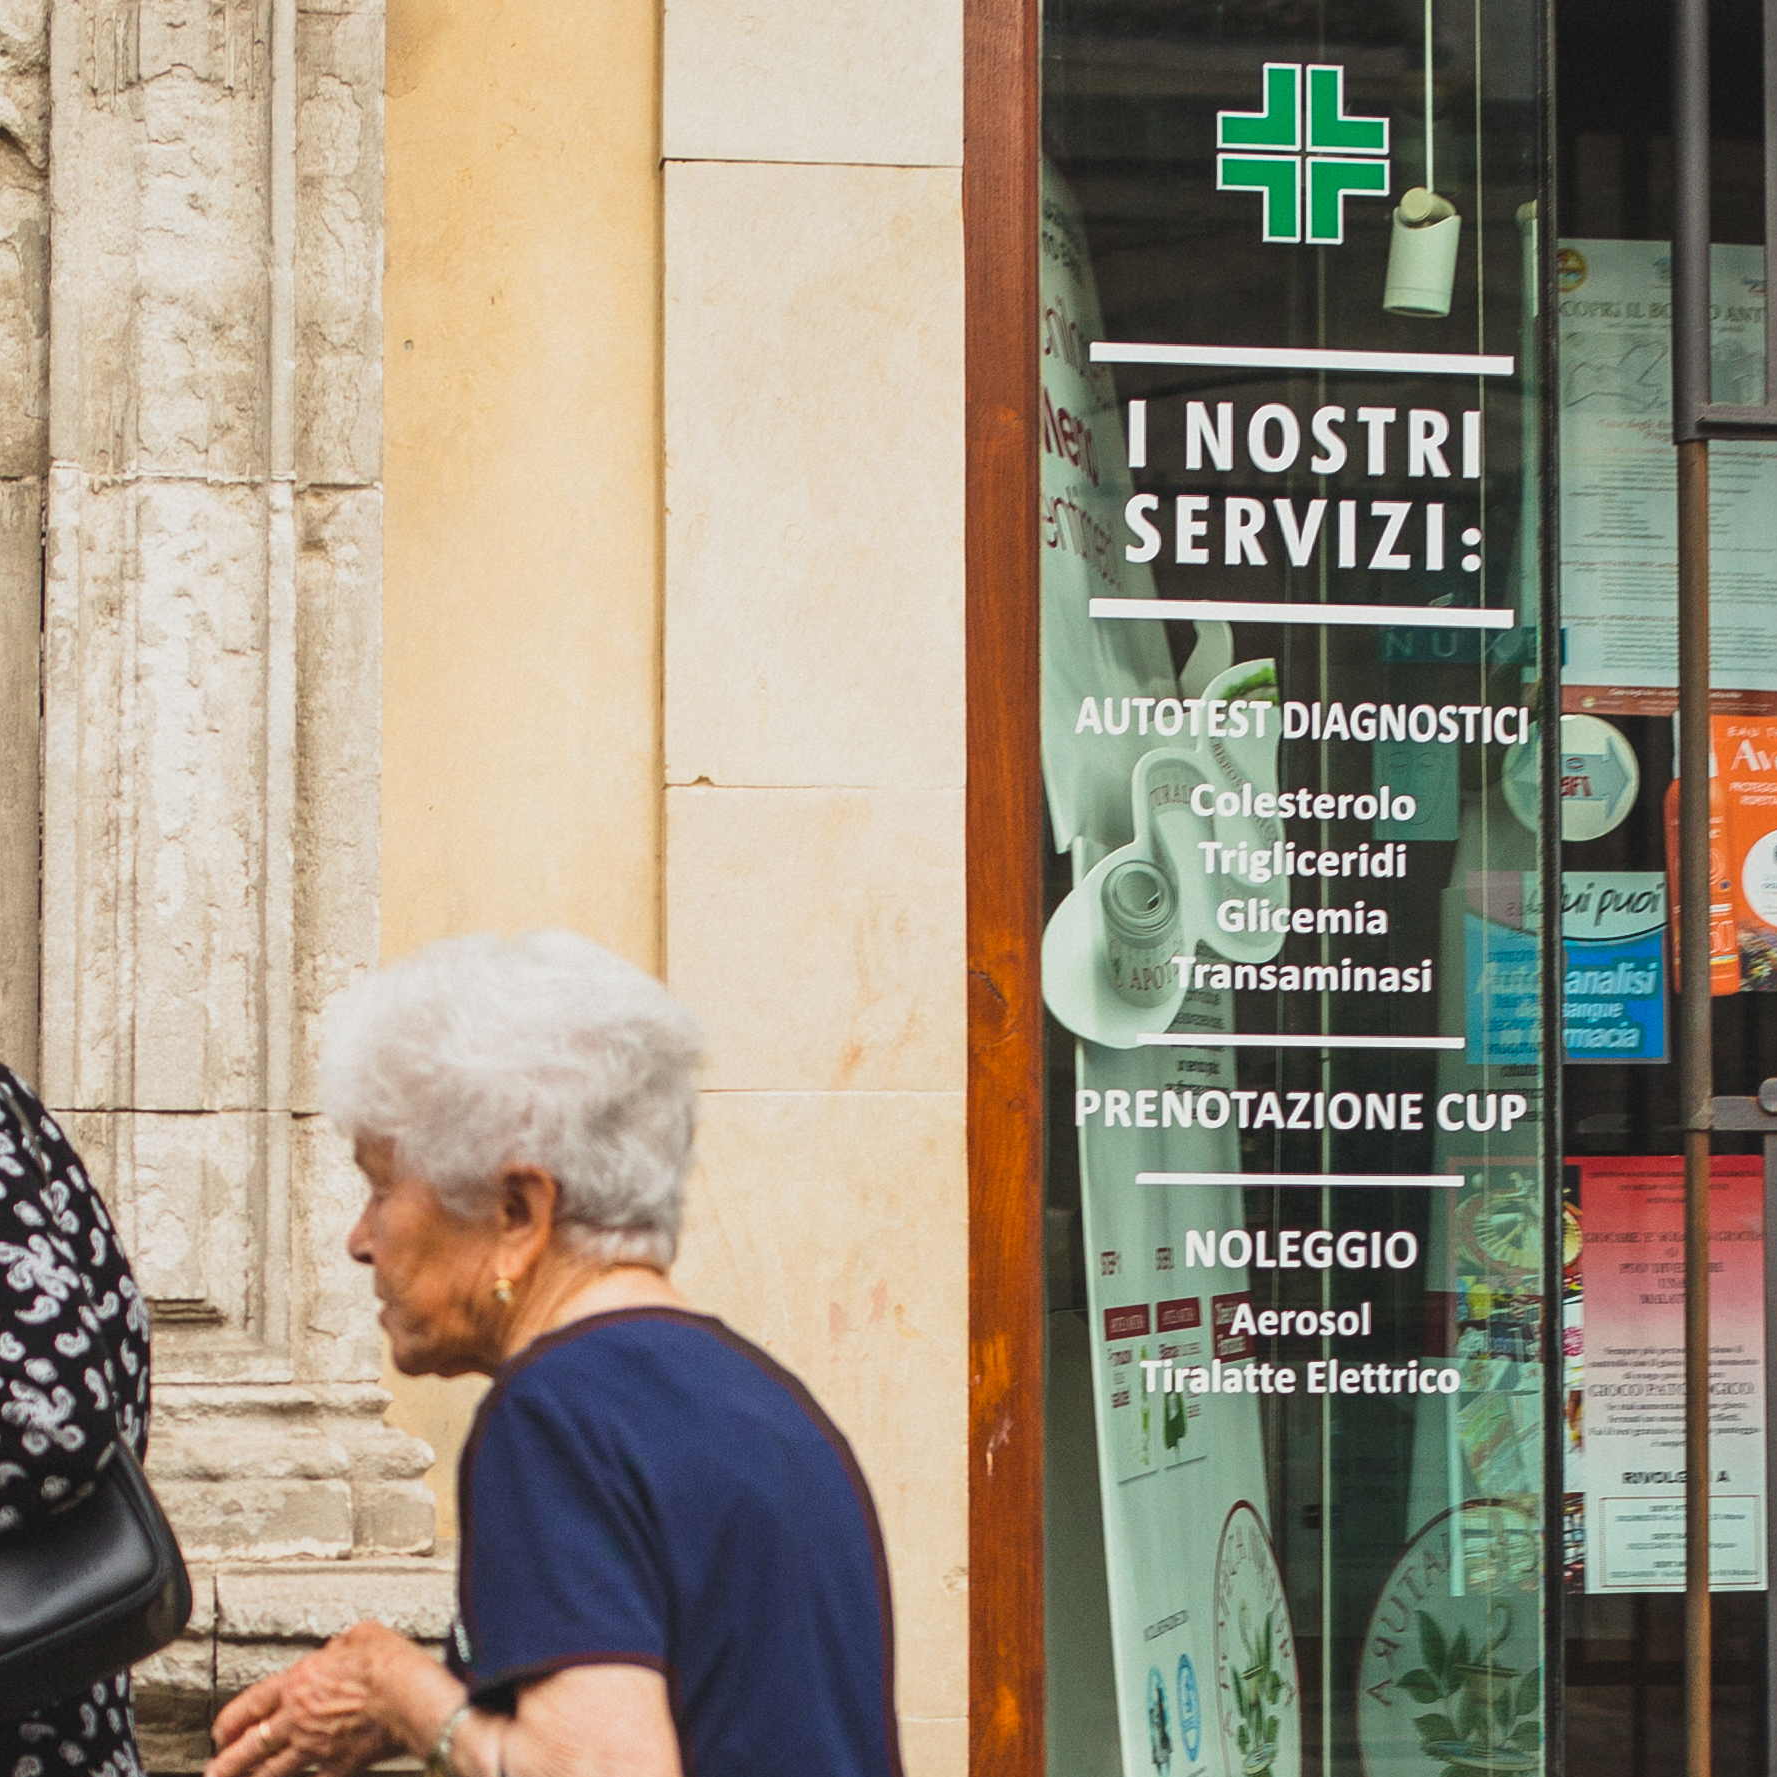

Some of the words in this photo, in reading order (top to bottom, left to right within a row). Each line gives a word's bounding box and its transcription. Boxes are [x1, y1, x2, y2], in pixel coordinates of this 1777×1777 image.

[1129, 400, 1146, 468] I
[1186, 402, 1481, 478] NOSTRI
[1124, 494, 1482, 571] SERVIZI:
[1075, 696, 1272, 738] AUTOTEST
[1283, 702, 1528, 746] DIAGNOSTICI
[1190, 783, 1416, 822] Colesterolo
[1198, 841, 1407, 884] Trigliceridi
[1217, 899, 1388, 936] Glicemia
[1594, 880, 1666, 928] puoi
[1171, 956, 1432, 993] Transaminasi
[1075, 1090, 1423, 1131] PRENOTAZIONE
[1437, 1093, 1527, 1132] CUP
[1185, 1229, 1417, 1270] NOLEGGIO
[1230, 1302, 1371, 1337] Aerosol
[1140, 1360, 1297, 1394] Tiralatte
[1307, 1361, 1460, 1395] Elettrico
